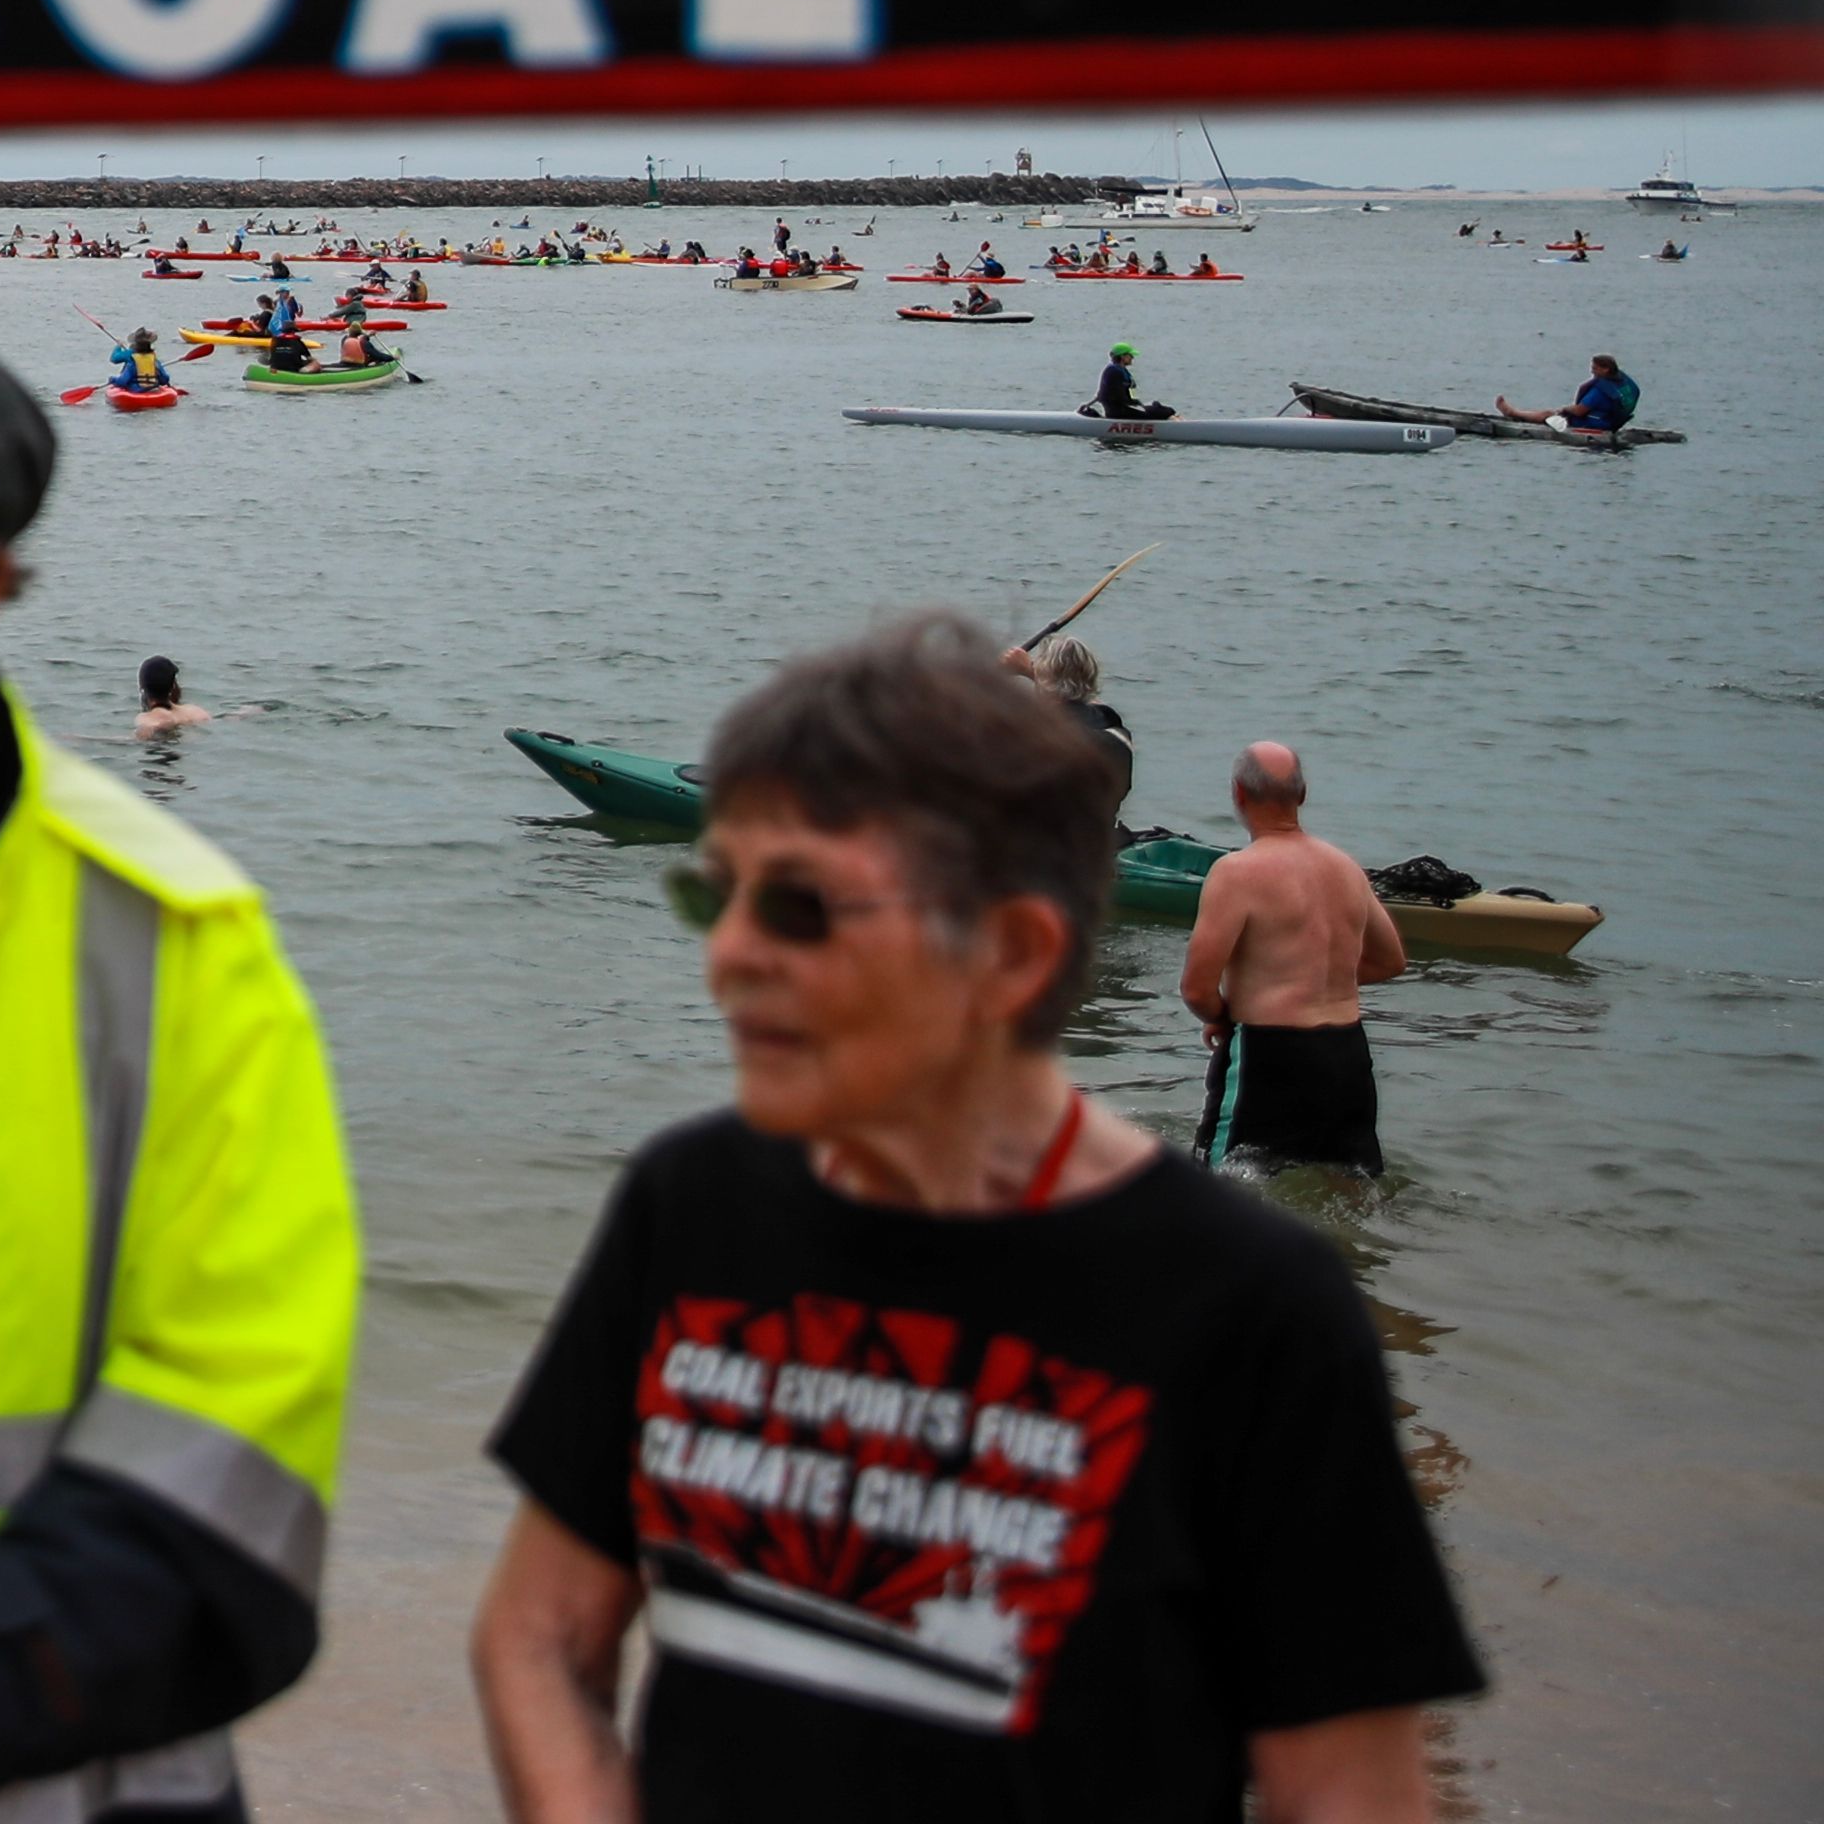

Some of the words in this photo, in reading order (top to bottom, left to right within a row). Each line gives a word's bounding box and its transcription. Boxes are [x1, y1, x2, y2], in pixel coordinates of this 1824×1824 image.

[1107, 422, 1155, 435] ARES
[661, 1339, 764, 1410] COAL
[773, 1363, 965, 1450] EXPORTS
[971, 1403, 1082, 1479] FUEL
[641, 1416, 848, 1519] CLIMATE
[852, 1465, 1067, 1569] CHANGE
